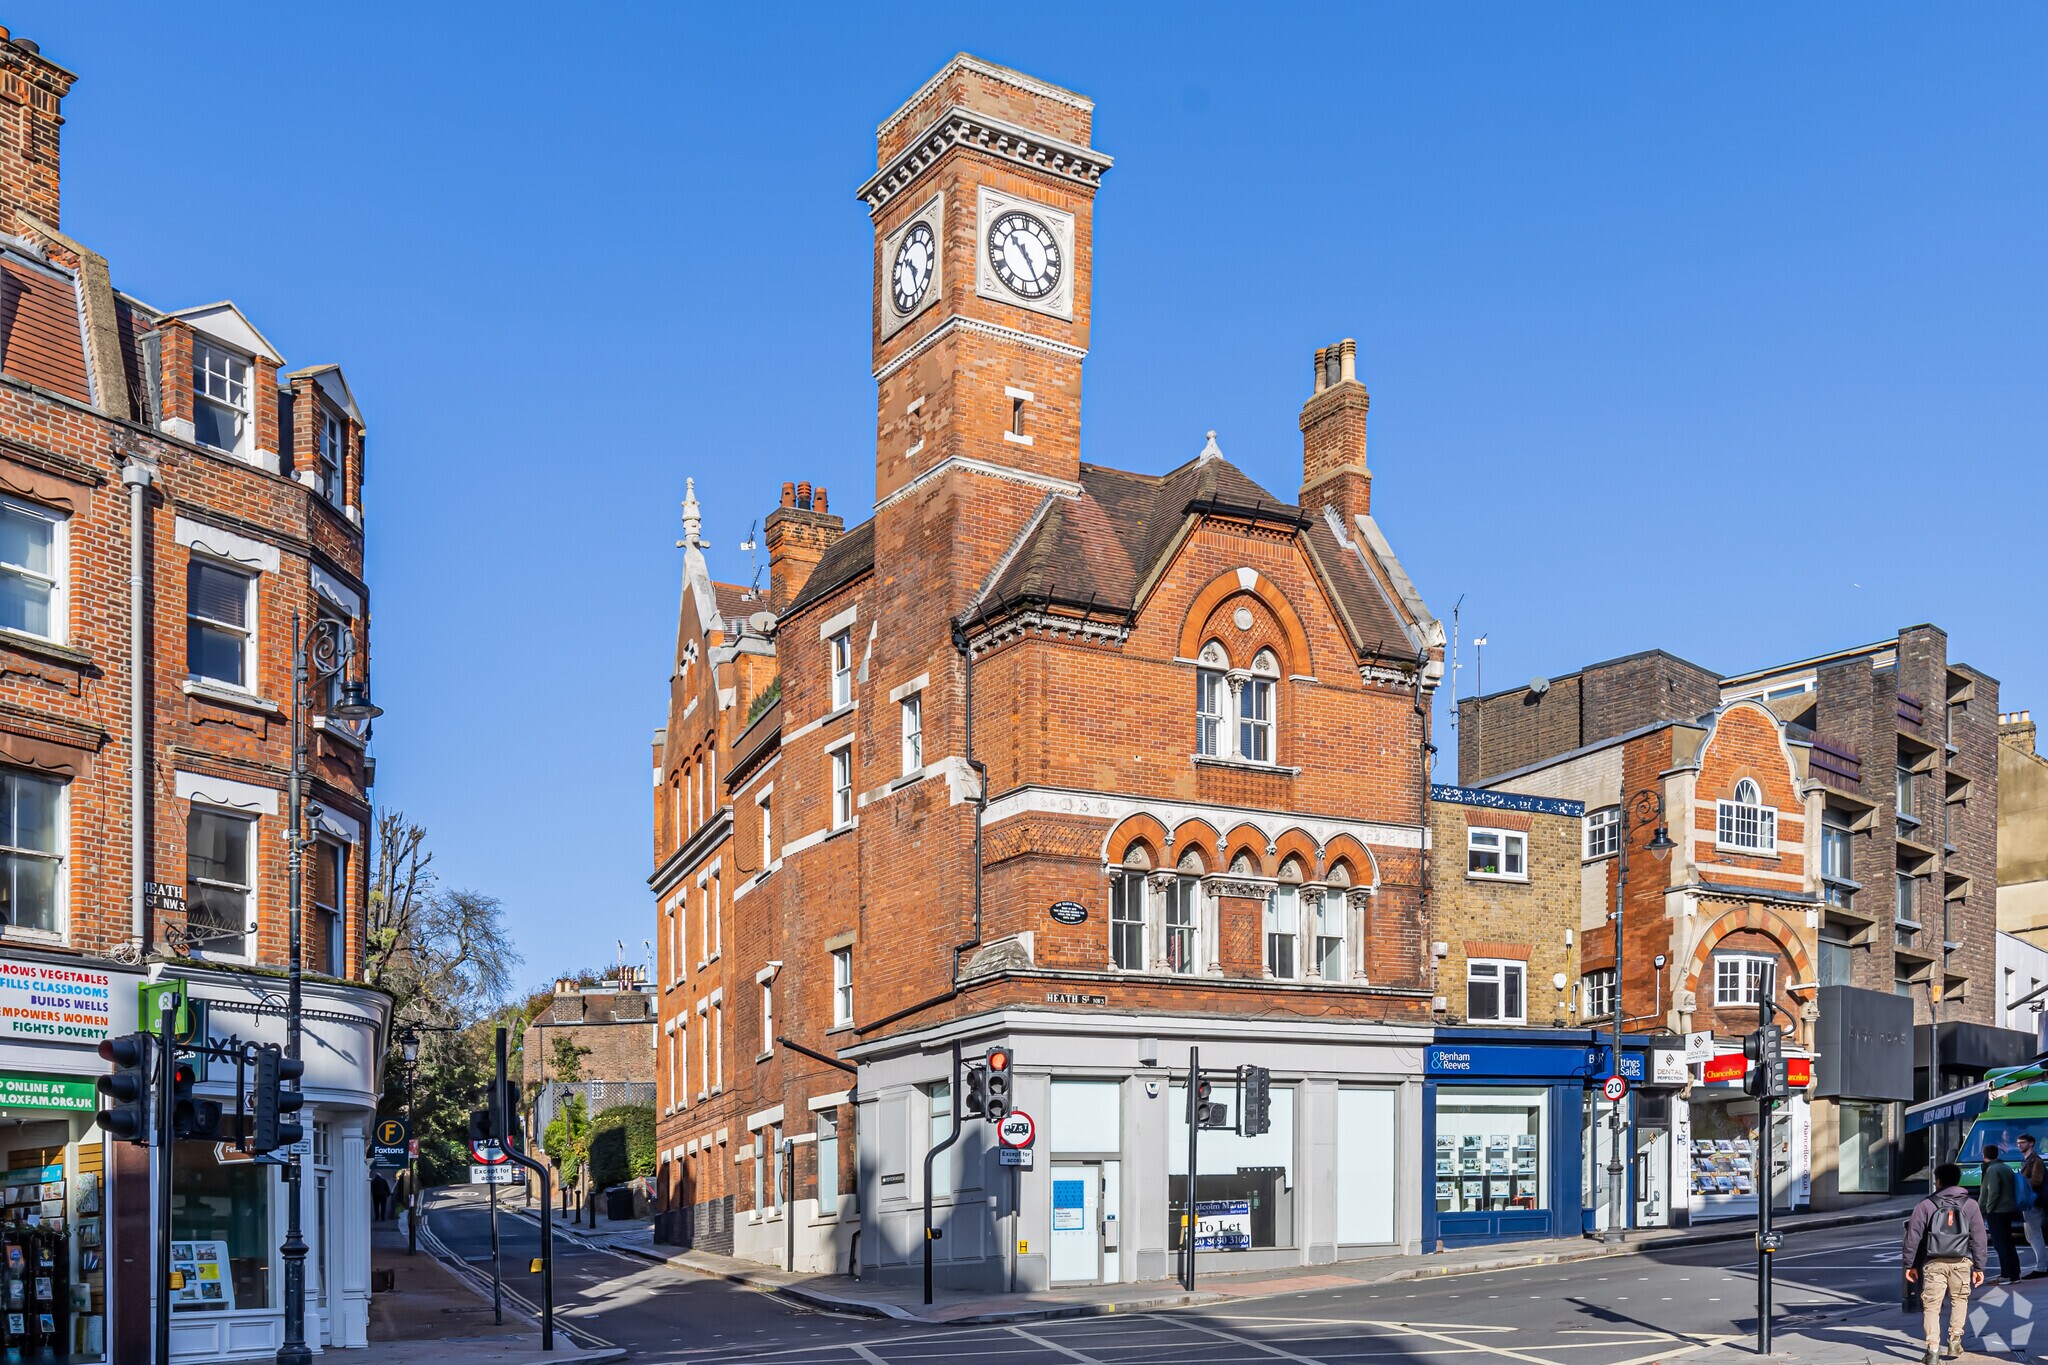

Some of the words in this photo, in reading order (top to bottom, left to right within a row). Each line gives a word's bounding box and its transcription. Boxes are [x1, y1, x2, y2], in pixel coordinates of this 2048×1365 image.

[40, 969, 108, 985] VEGETABLES
[33, 981, 108, 998] CLASSROOMS
[31, 995, 70, 1008] BUILDS
[74, 1000, 108, 1012] WELLS
[1048, 994, 1078, 1003] HEATH
[0, 1007, 60, 1022] MPOWERS
[64, 1013, 108, 1026] WOMEN
[12, 1022, 54, 1034] FIGHTS
[58, 1026, 108, 1039] POVERTY
[1440, 1052, 1470, 1060] Benham
[1444, 1060, 1470, 1069] Reeves
[1620, 1058, 1640, 1068] ttings
[1620, 1067, 1640, 1076] Sales
[1706, 1068, 1741, 1078] Chancellors
[1788, 1073, 1808, 1081] ancellors
[6, 1081, 48, 1093] ONLINE
[51, 1084, 65, 1094] AT
[1608, 1083, 1621, 1093] 20
[385, 1123, 397, 1142] F
[374, 1146, 404, 1154] Foxtons
[1198, 1222, 1214, 1232] To
[1218, 1220, 1241, 1231] Let
[1207, 1236, 1226, 1245] 8690
[1229, 1235, 1248, 1244] 3100
[1020, 1241, 1027, 1252] H
